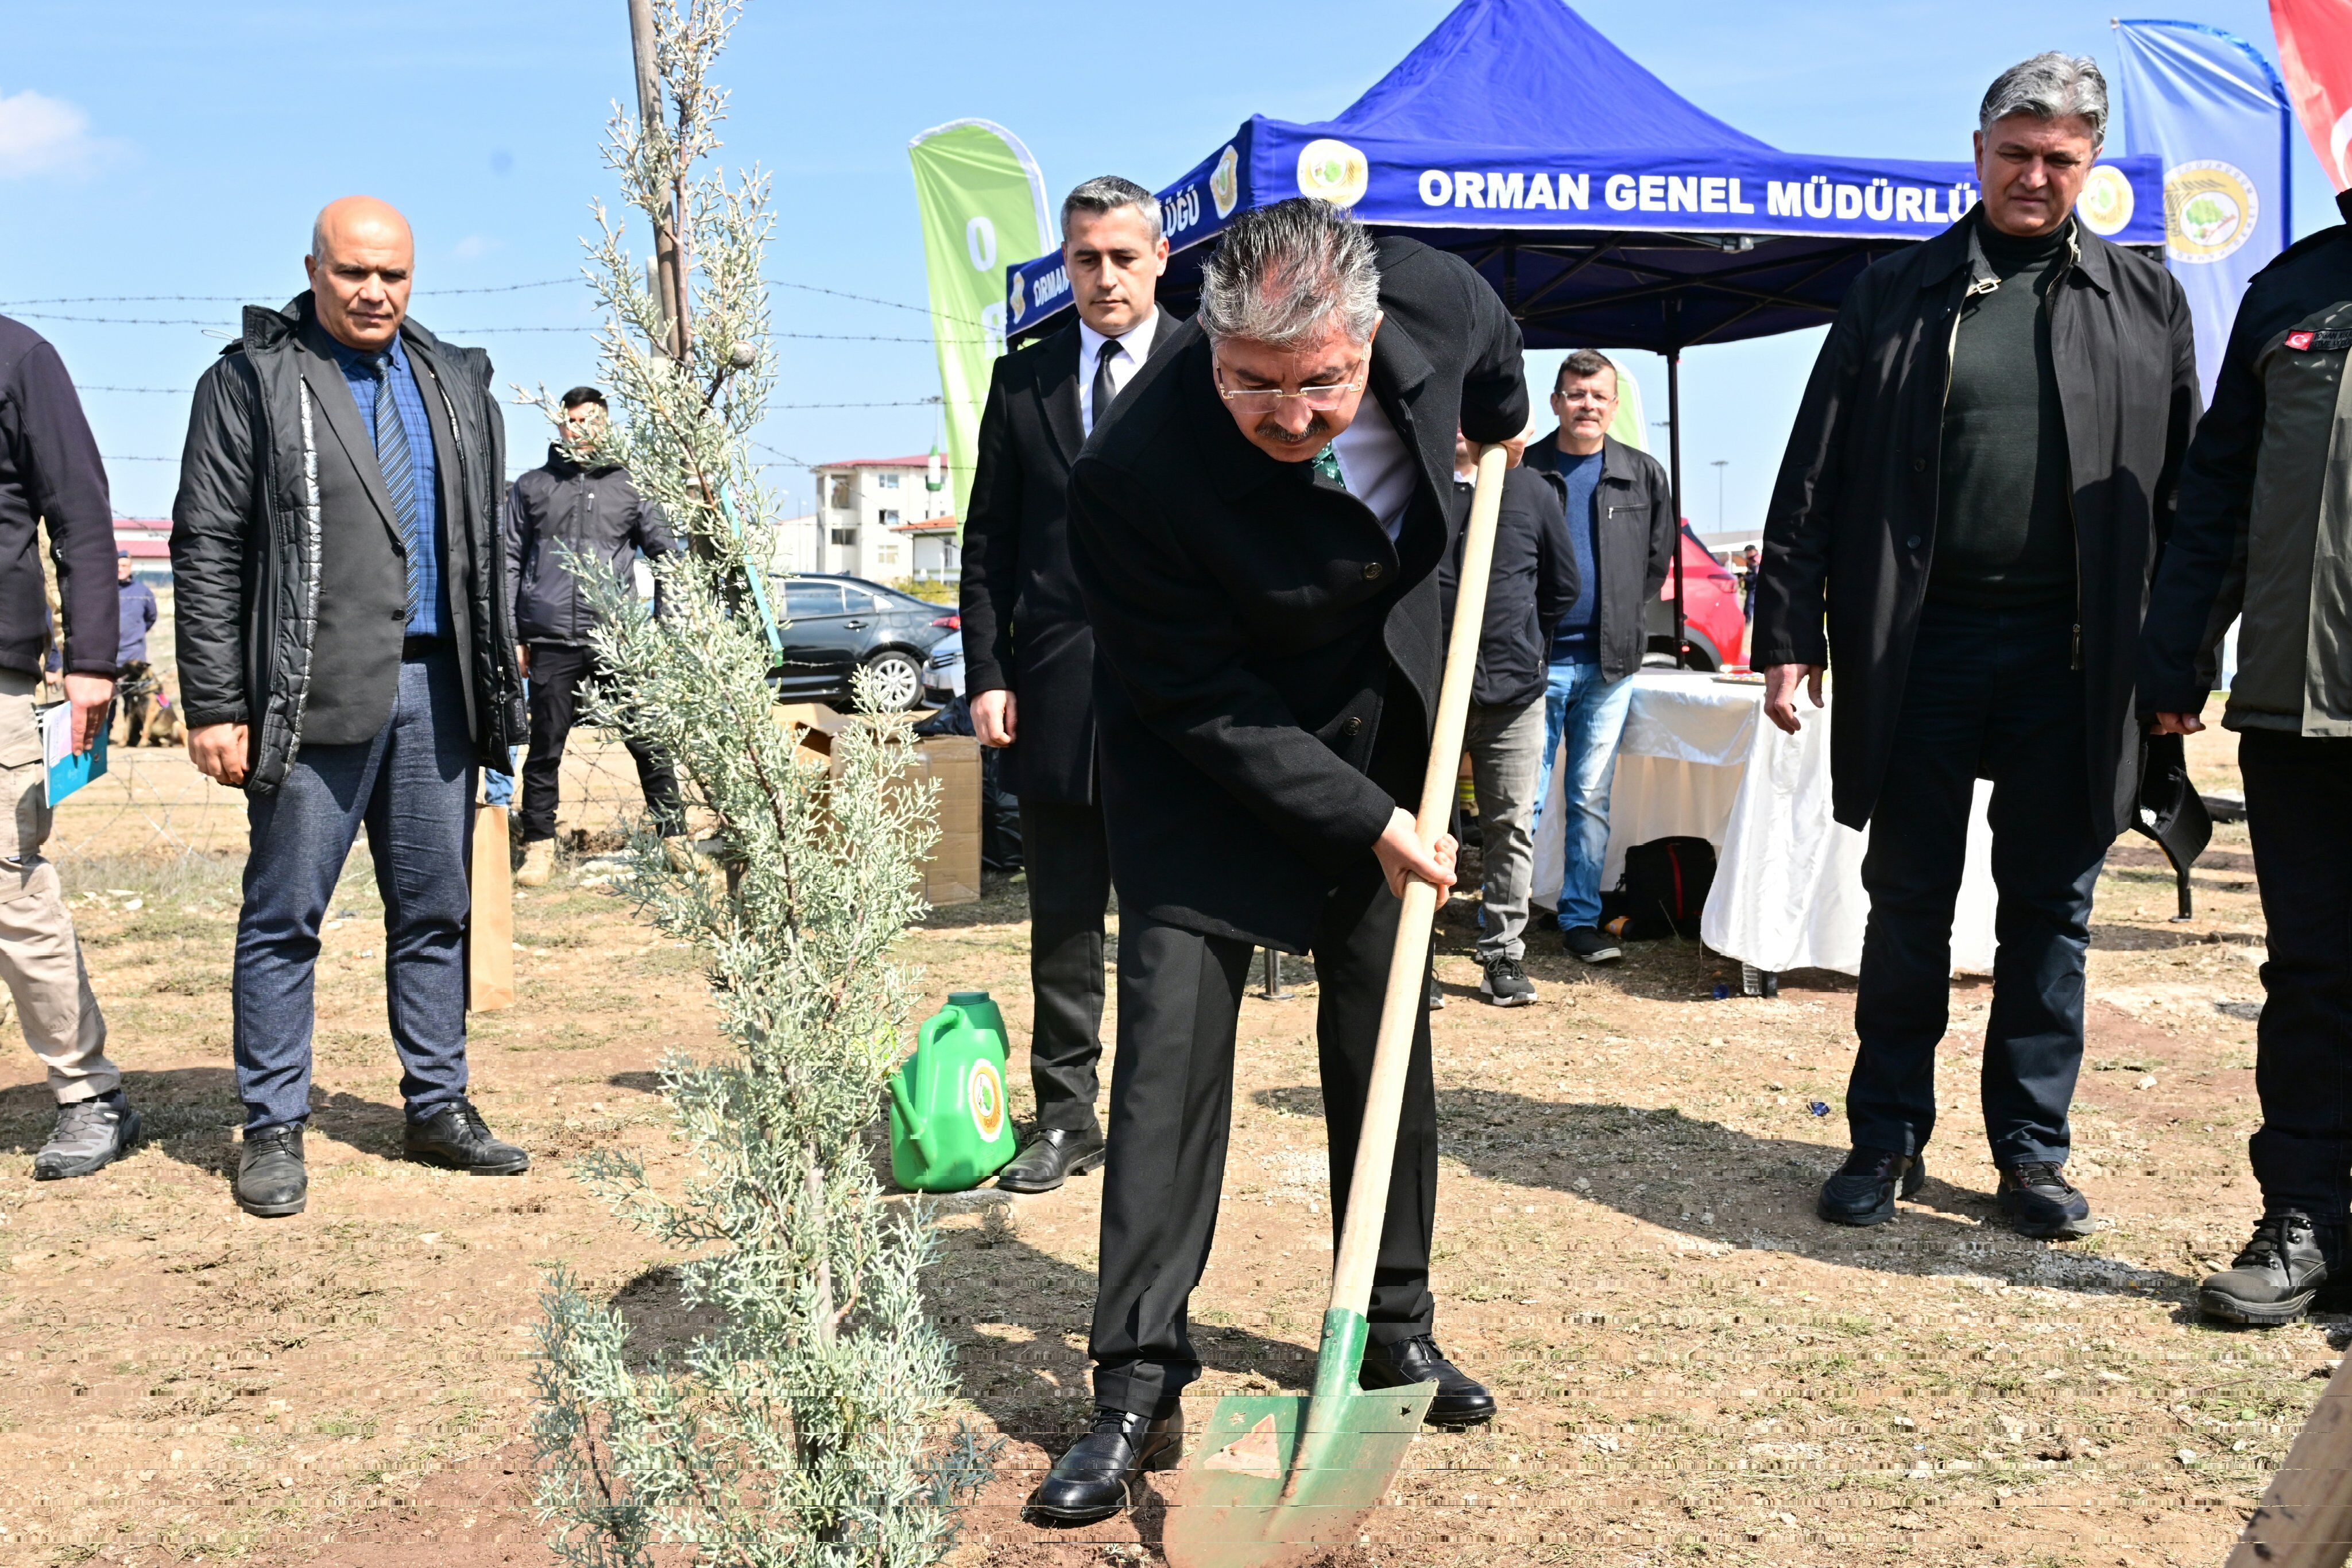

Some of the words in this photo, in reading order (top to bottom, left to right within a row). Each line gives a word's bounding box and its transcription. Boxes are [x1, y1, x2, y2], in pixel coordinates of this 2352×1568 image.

[1160, 183, 1200, 238] LÜĞÜ
[1419, 169, 1589, 210] ORMAN
[1605, 174, 1754, 214] GENEL
[1767, 176, 1981, 223] MÜDÜRLÜ
